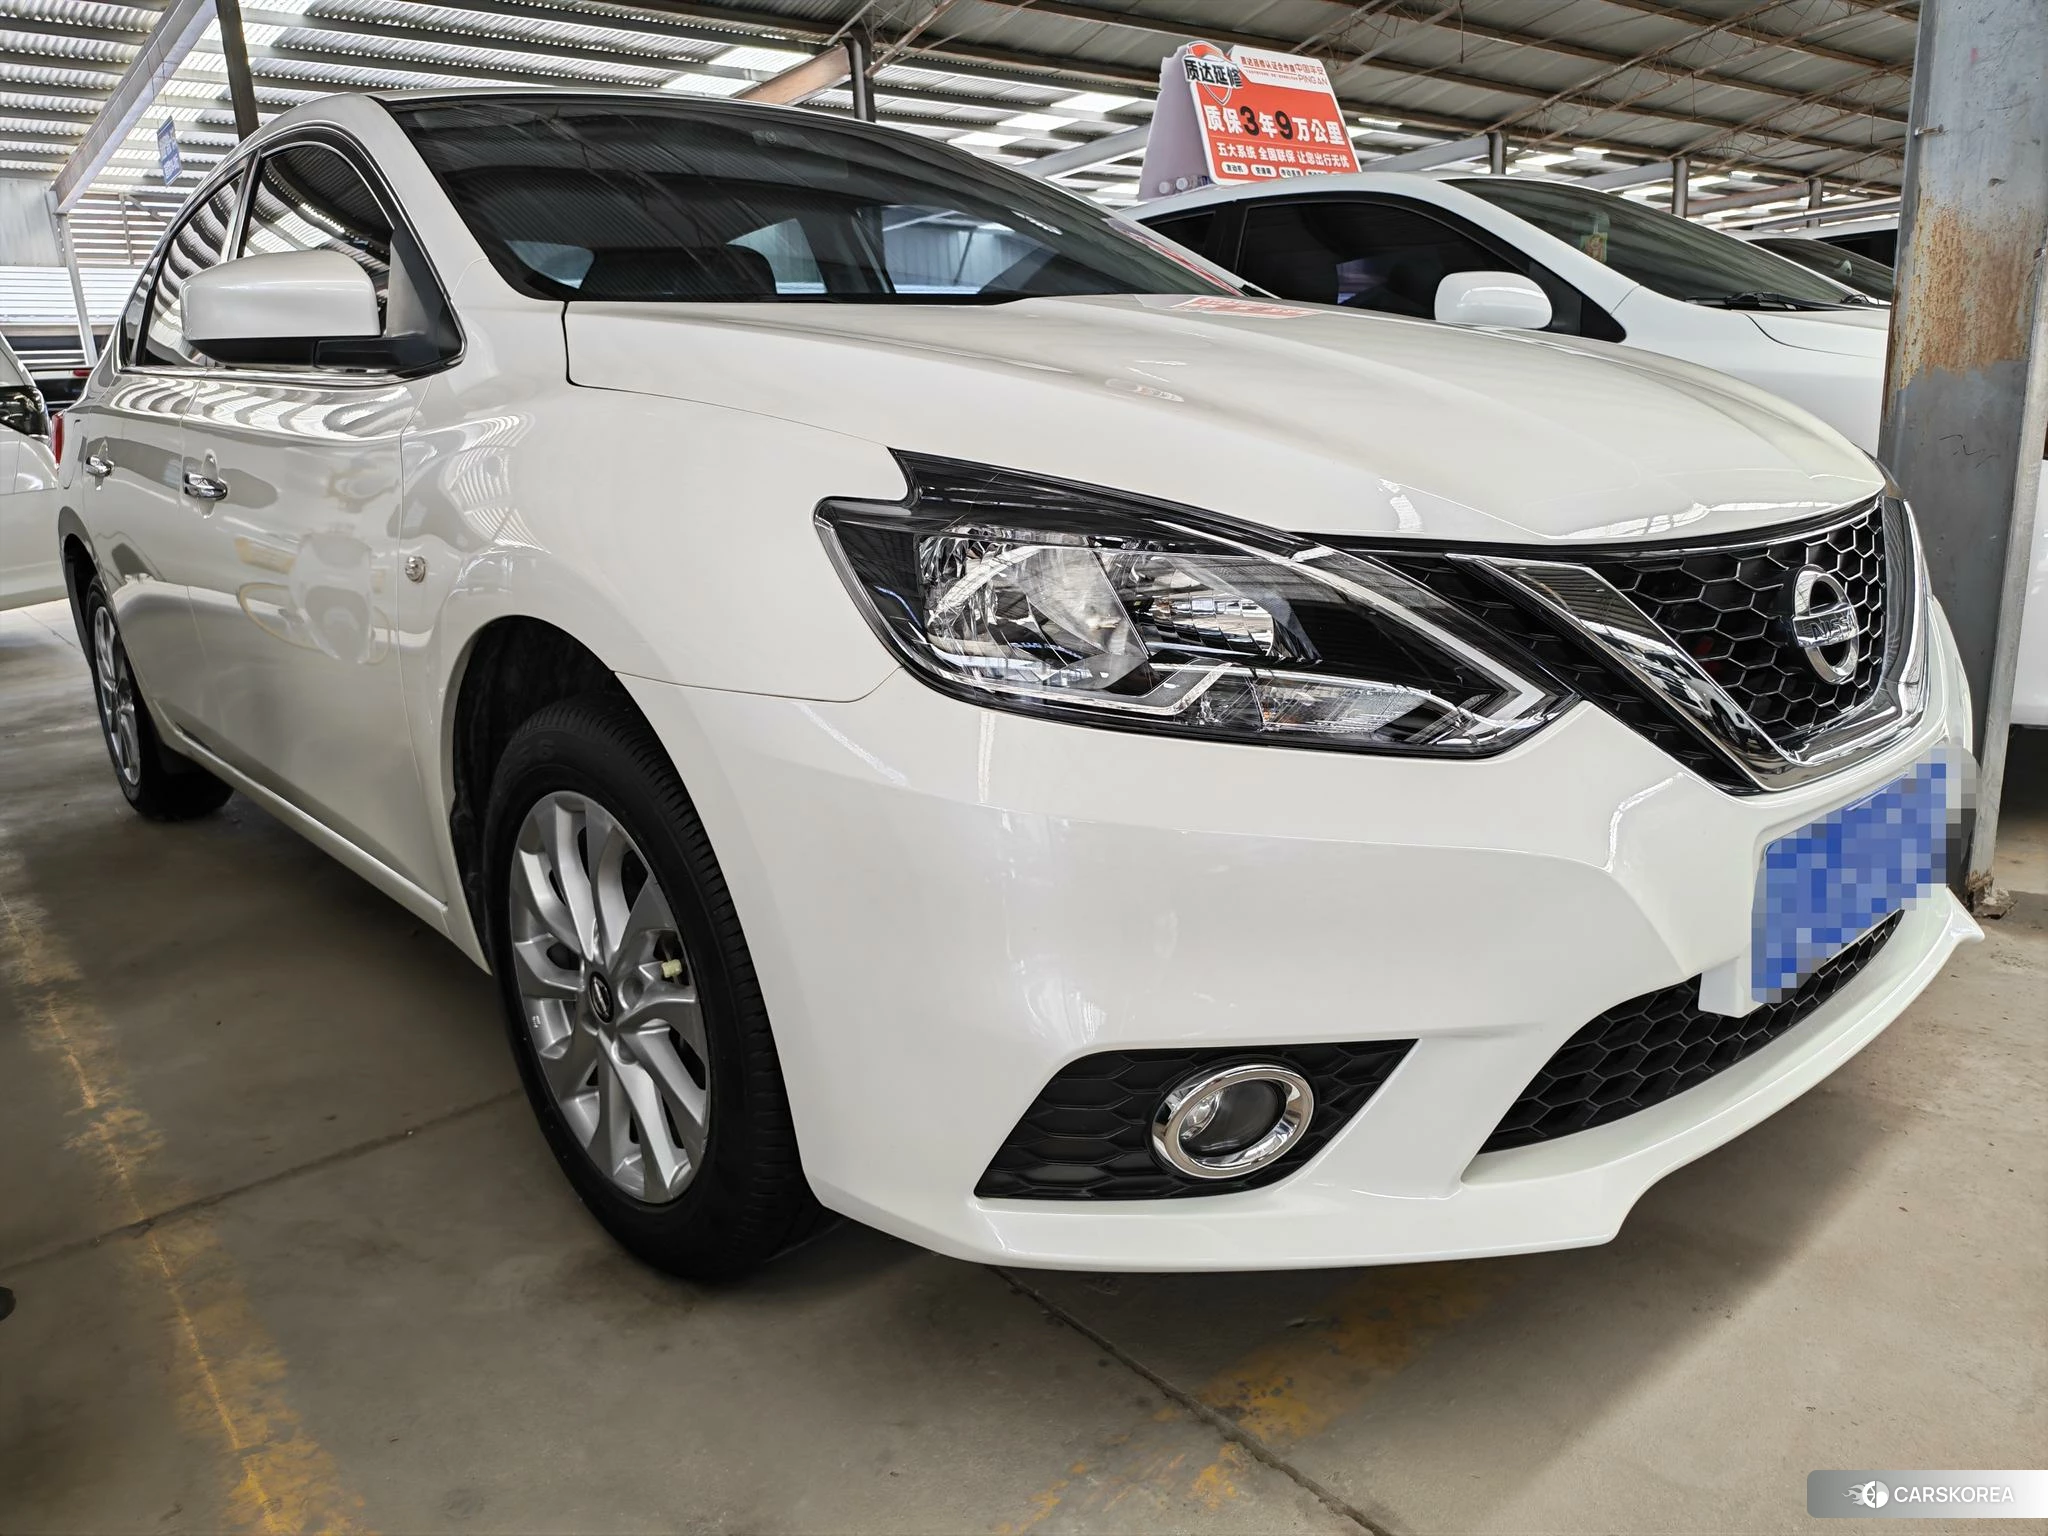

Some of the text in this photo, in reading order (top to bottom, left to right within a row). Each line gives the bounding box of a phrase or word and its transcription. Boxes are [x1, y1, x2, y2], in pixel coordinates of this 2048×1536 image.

[1184, 59, 1243, 87] 质达延修
[1203, 104, 1346, 145] 质保3年9万公里
[1216, 142, 1257, 160] 五大系统
[1258, 147, 1296, 164] 全国联保
